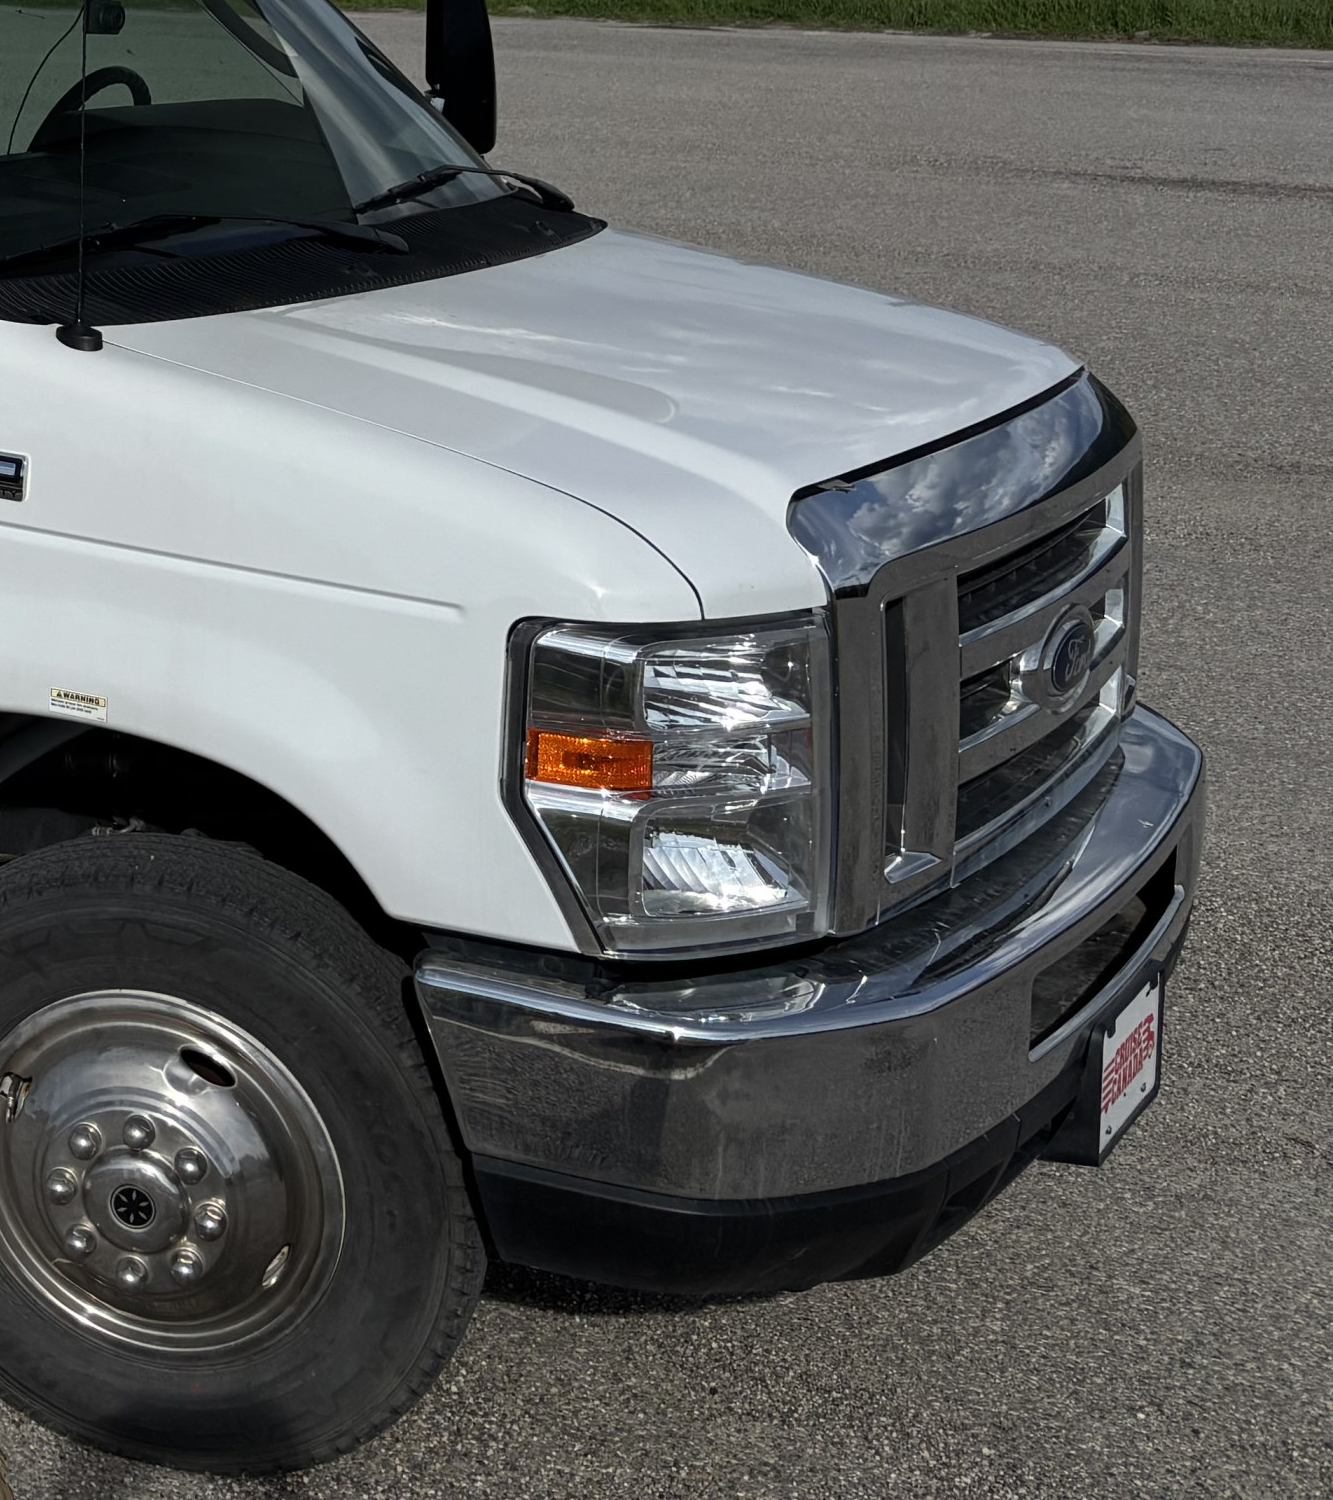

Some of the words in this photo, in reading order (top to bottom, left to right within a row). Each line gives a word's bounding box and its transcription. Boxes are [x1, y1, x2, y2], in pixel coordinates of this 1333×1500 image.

[1065, 634, 1090, 681] Ford
[63, 691, 100, 706] WARNING
[1114, 1020, 1143, 1075] CRUISE
[1110, 1046, 1144, 1106] CANADA
